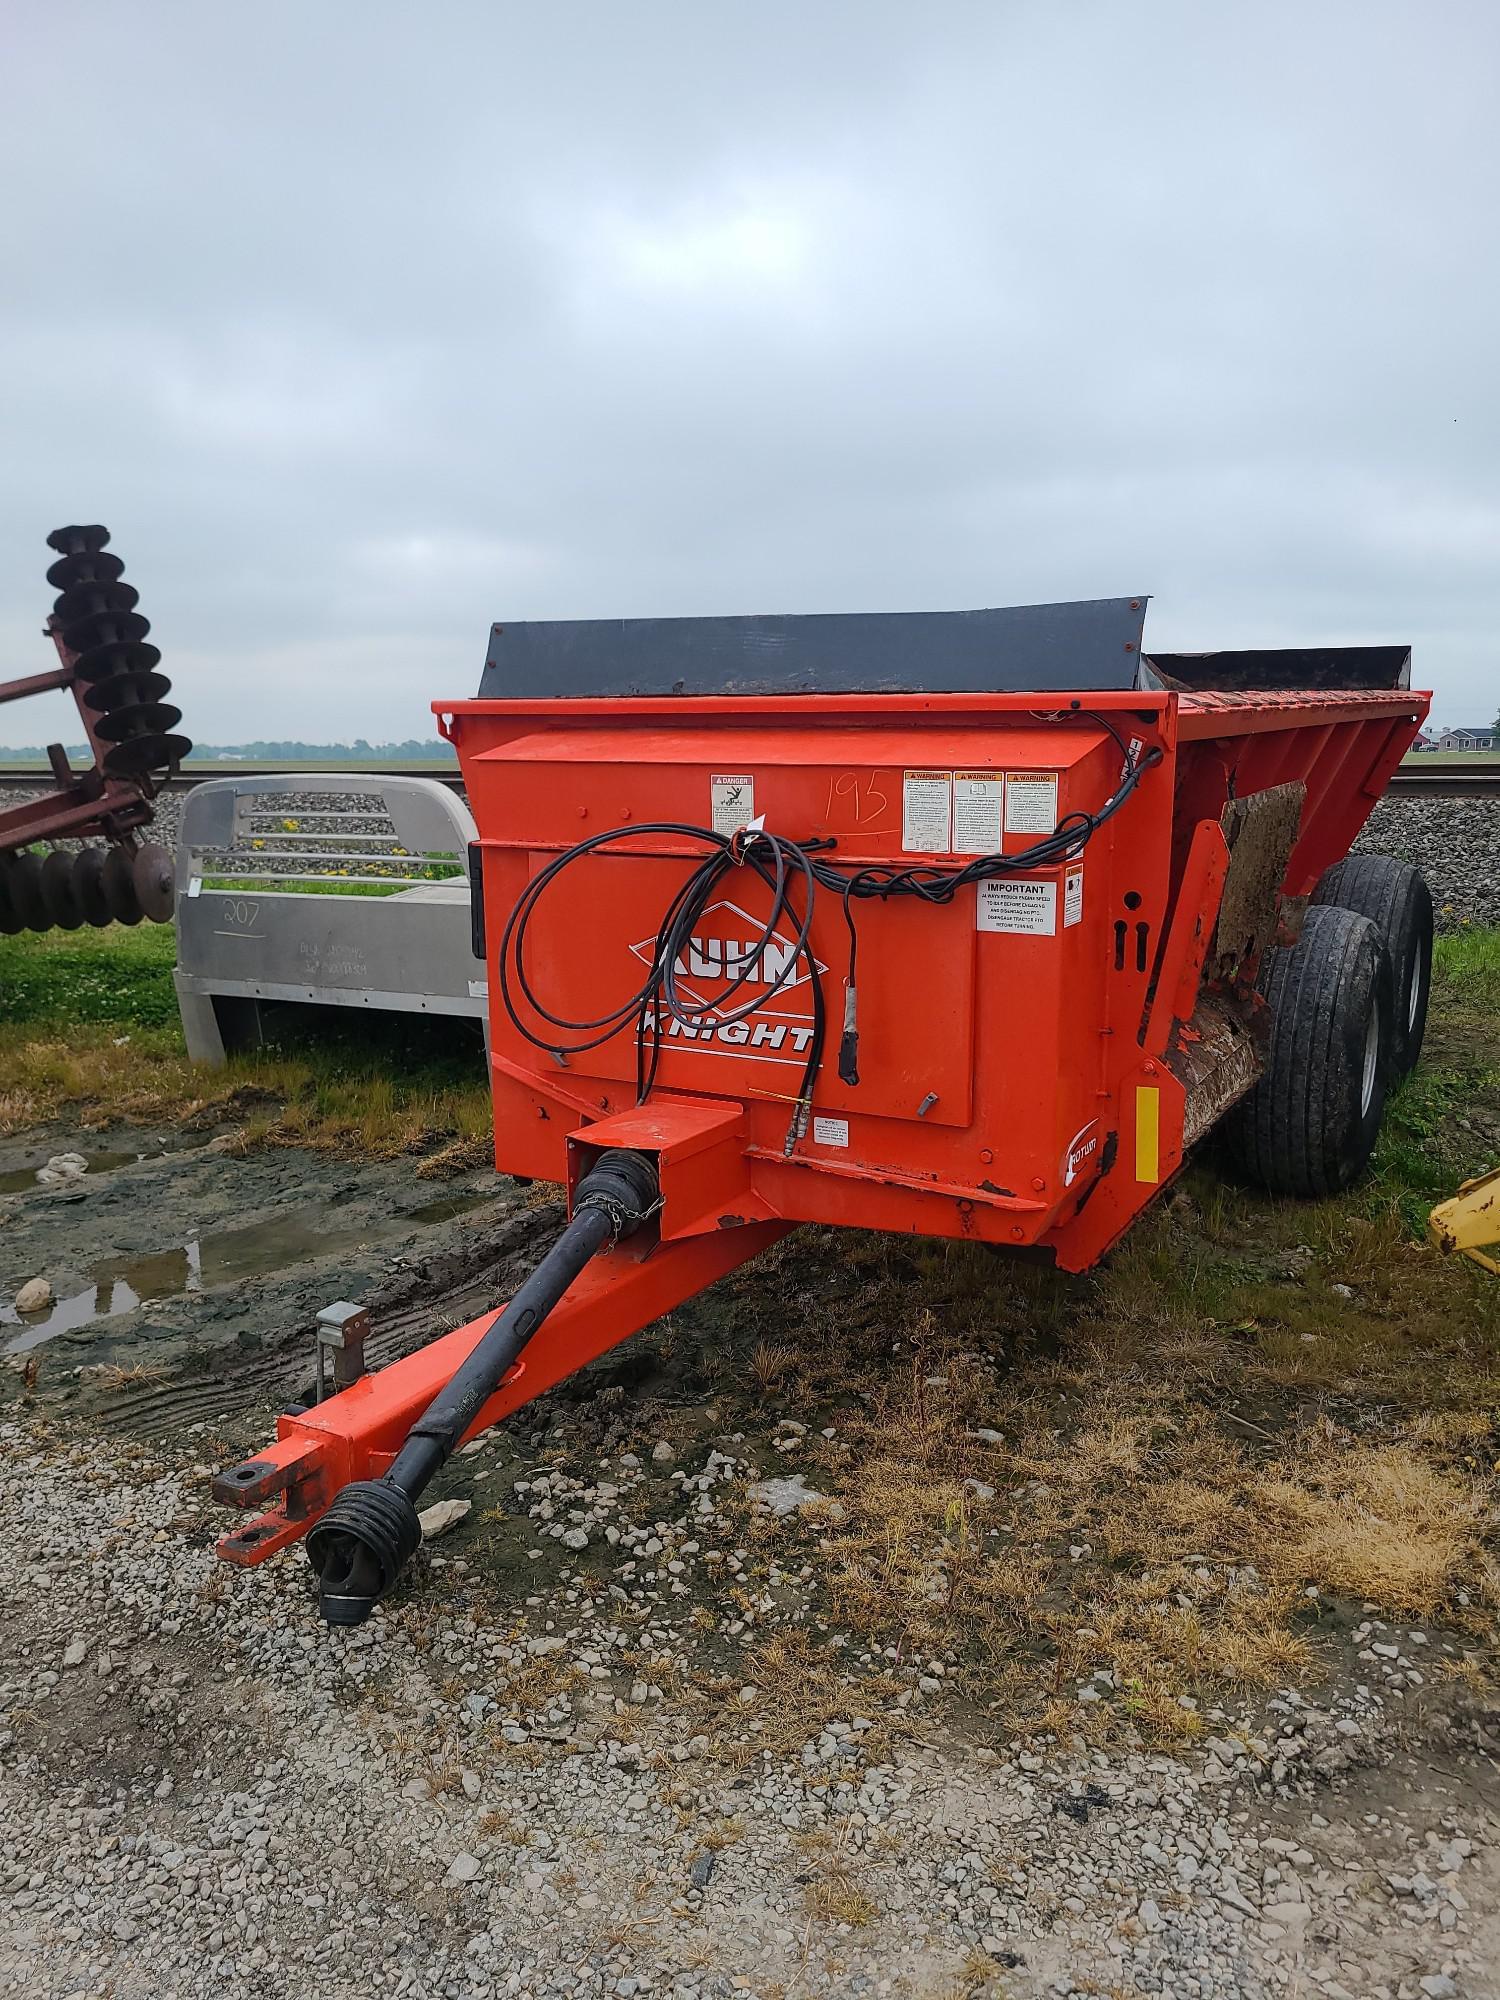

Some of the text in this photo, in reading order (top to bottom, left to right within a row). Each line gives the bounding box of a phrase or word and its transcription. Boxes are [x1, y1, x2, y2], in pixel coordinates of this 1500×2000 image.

[722, 777, 748, 785] DANGER
[825, 769, 891, 824] 195
[987, 883, 1045, 894] IMPORTANT
[222, 899, 260, 927] 207
[635, 1010, 815, 1052] KNIGHT
